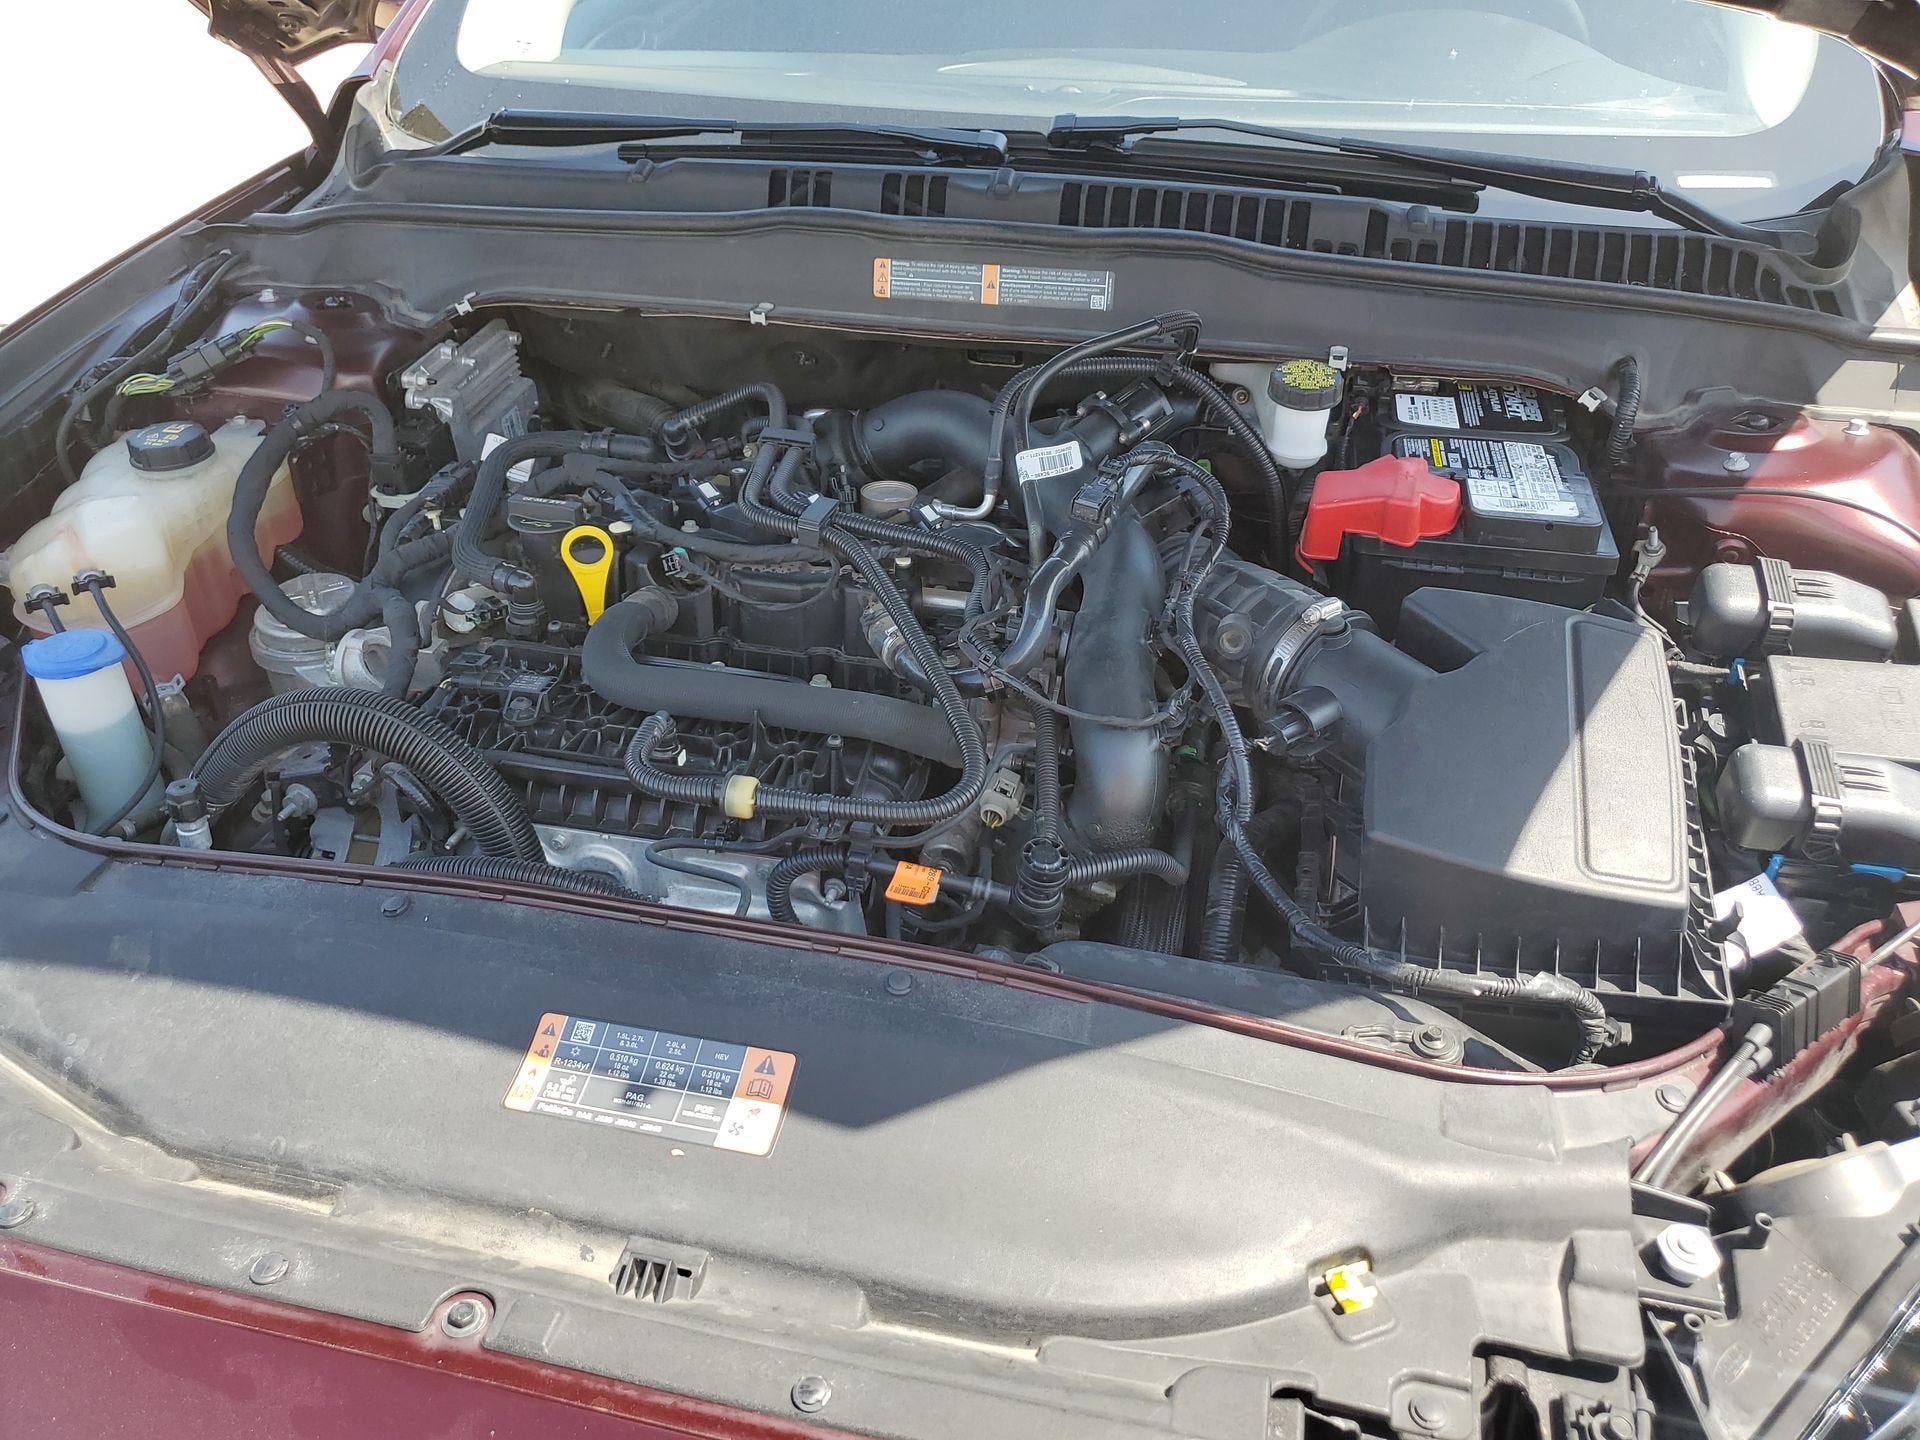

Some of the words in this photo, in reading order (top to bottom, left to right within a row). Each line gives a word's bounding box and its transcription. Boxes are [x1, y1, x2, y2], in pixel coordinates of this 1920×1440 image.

[1502, 383, 1527, 420] START
[1520, 386, 1543, 421] SUPER
[632, 1034, 645, 1043] 2.7L
[666, 1040, 679, 1048] 2.0L
[668, 1048, 682, 1056] 2.5L
[714, 1053, 730, 1061] HEV
[554, 1057, 590, 1071] R-1234yf
[609, 1052, 629, 1063] 0.510
[629, 1056, 639, 1066] kg
[655, 1061, 674, 1072] 0.624
[675, 1064, 685, 1074] kg
[608, 1068, 620, 1077] 1.12
[620, 1070, 630, 1079] lbs
[701, 1069, 720, 1079] 0.510
[721, 1072, 730, 1083] kg
[666, 1079, 676, 1088] lbs
[625, 1091, 644, 1101] PAG
[700, 1085, 712, 1094] 1.12
[712, 1087, 723, 1096] lbs
